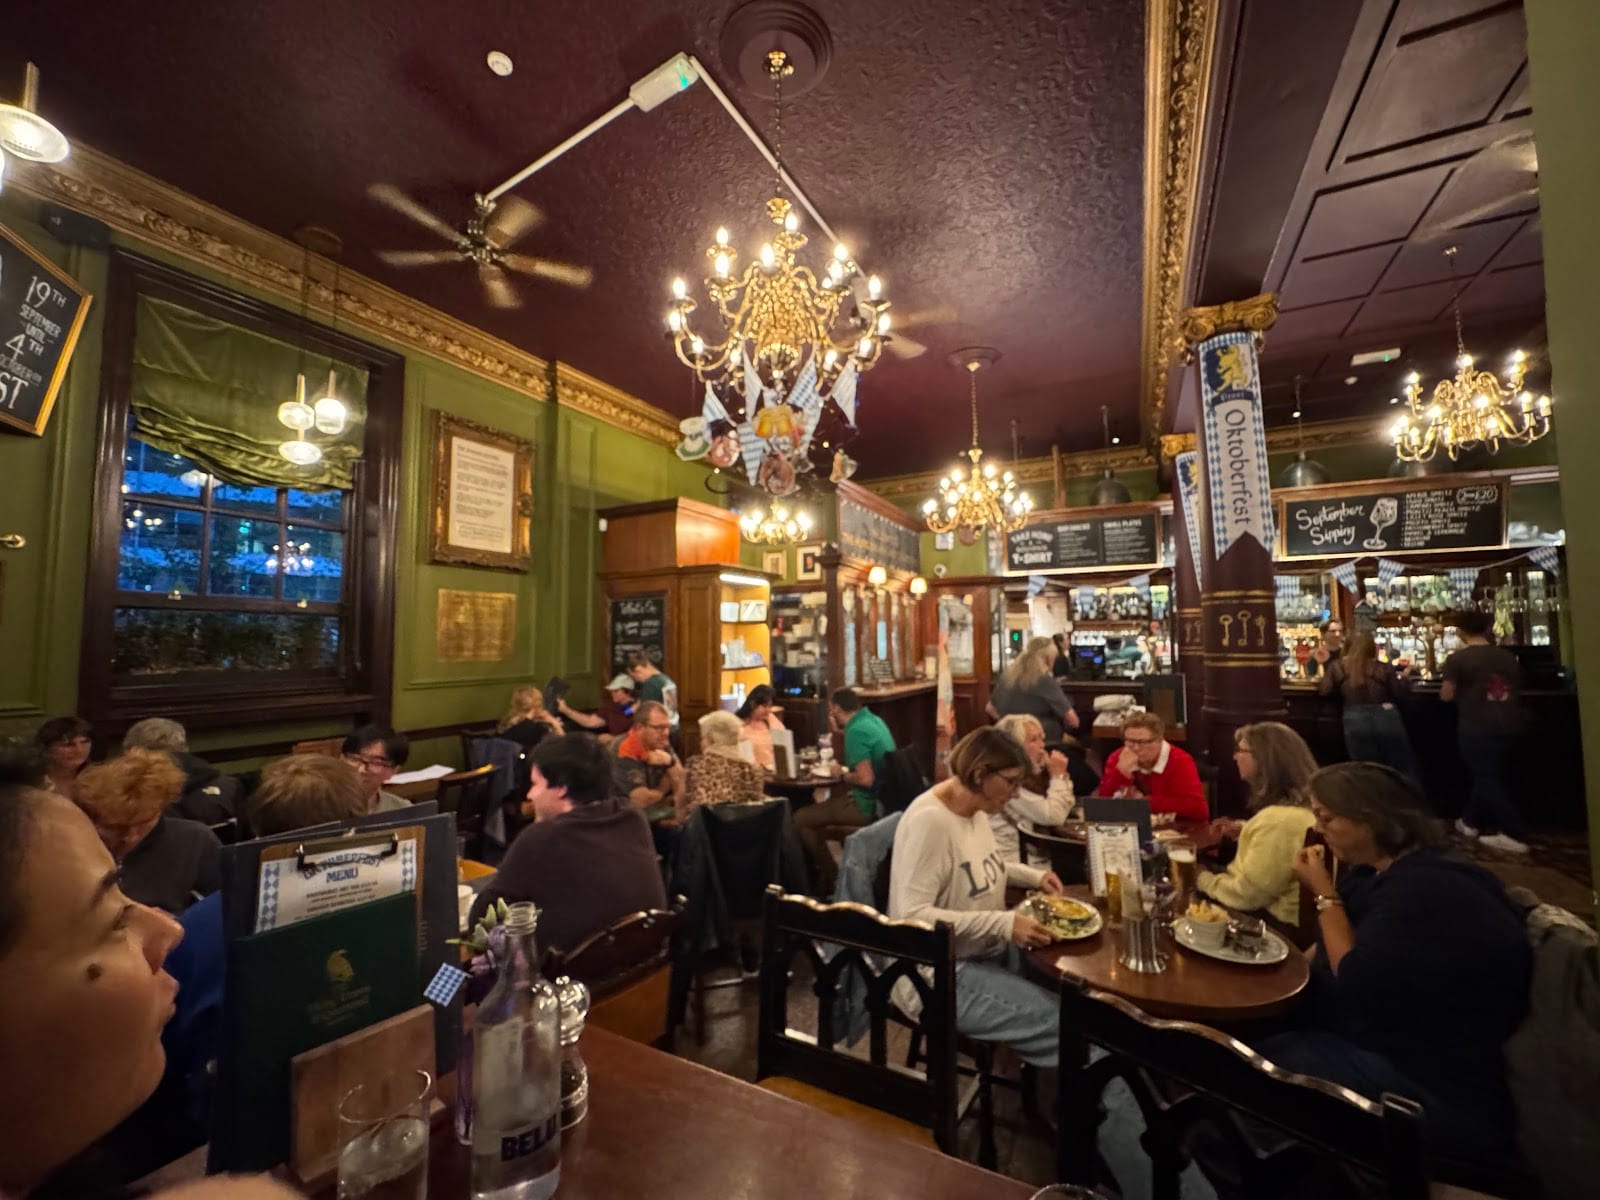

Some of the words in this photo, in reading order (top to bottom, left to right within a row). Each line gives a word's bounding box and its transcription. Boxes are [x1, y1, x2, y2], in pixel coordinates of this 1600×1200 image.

[20, 304, 61, 338] SEPTEMBER
[26, 323, 45, 344] UNTIL
[1225, 408, 1252, 525] Oktoberfest
[1295, 502, 1365, 530] September
[1310, 524, 1356, 546] Sipping
[1011, 551, 1053, 565] T-SHIRT
[326, 866, 359, 884] MENU
